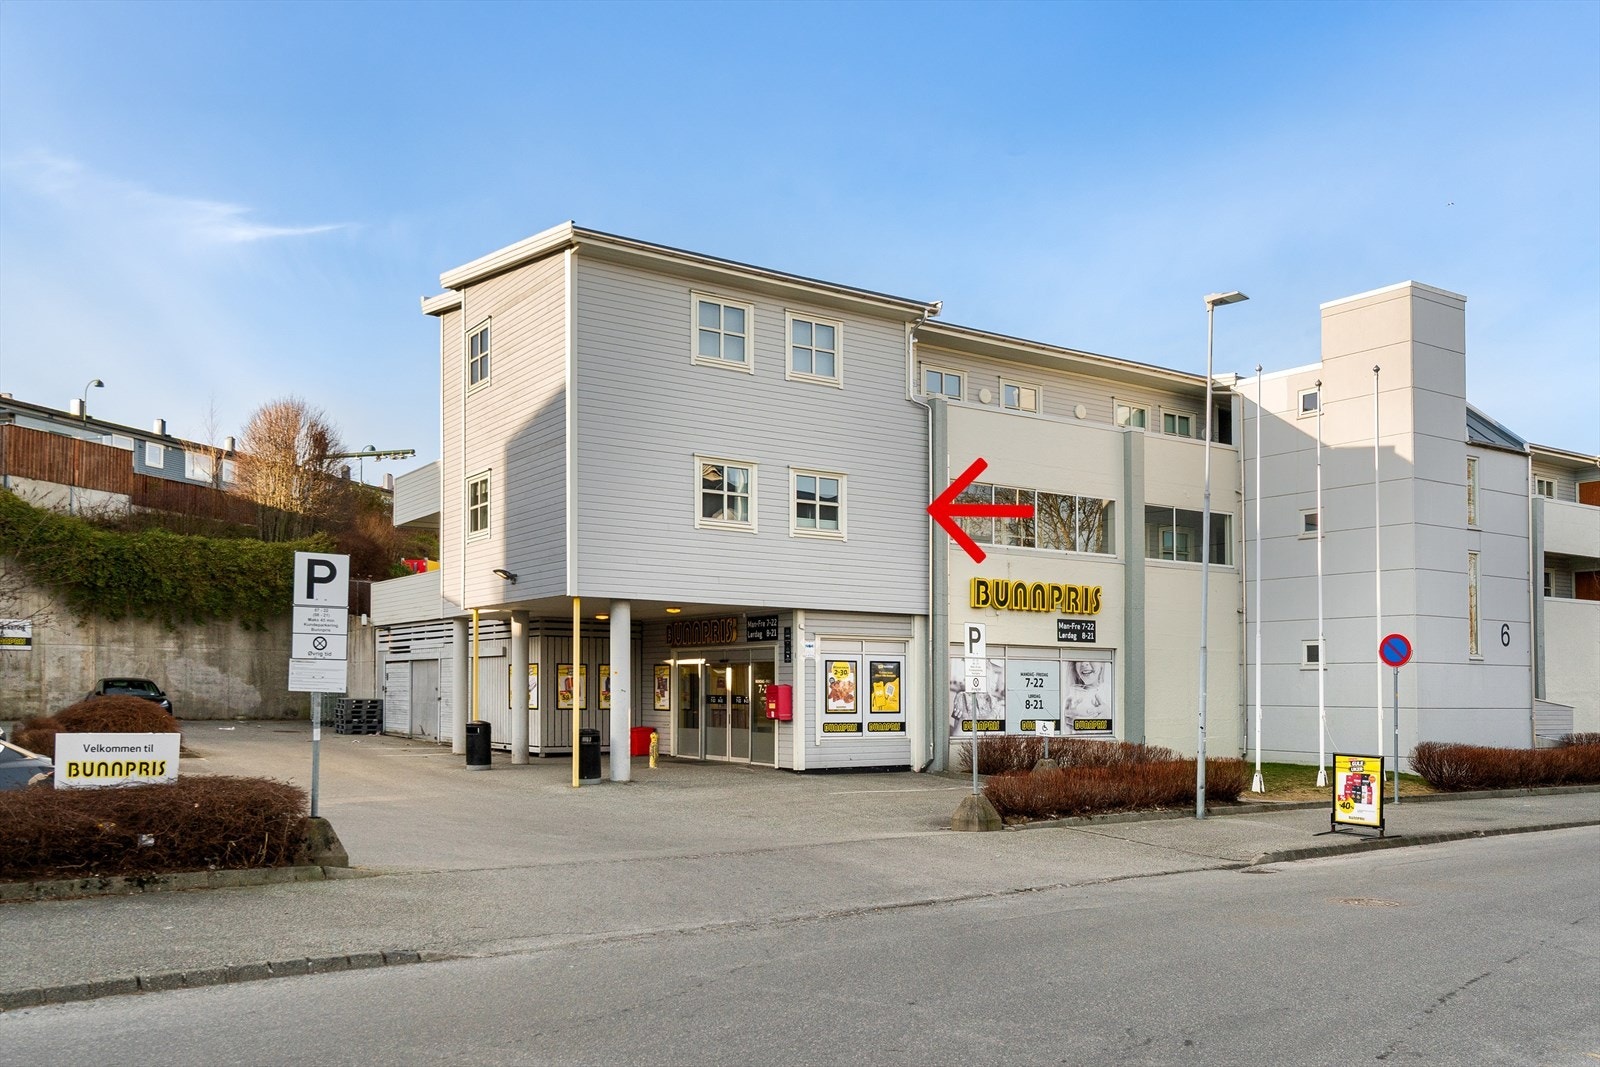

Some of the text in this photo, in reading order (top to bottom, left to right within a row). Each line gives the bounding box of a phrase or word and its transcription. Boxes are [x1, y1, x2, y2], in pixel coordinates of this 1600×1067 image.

[307, 558, 337, 599] P
[970, 578, 1101, 614] BUNNPRIS
[766, 618, 777, 627] 7-22
[1058, 621, 1095, 630] Man-Fre 7-22
[747, 629, 777, 639] Lørdag 8-21
[1058, 631, 1095, 641] Lørdag 8-21
[1501, 623, 1510, 647] 6
[969, 628, 981, 653] P
[1025, 678, 1044, 688] 7-22
[1025, 700, 1044, 709] 8-21
[83, 744, 154, 753] Velkommen til
[67, 761, 166, 778] BUNNPRIS
